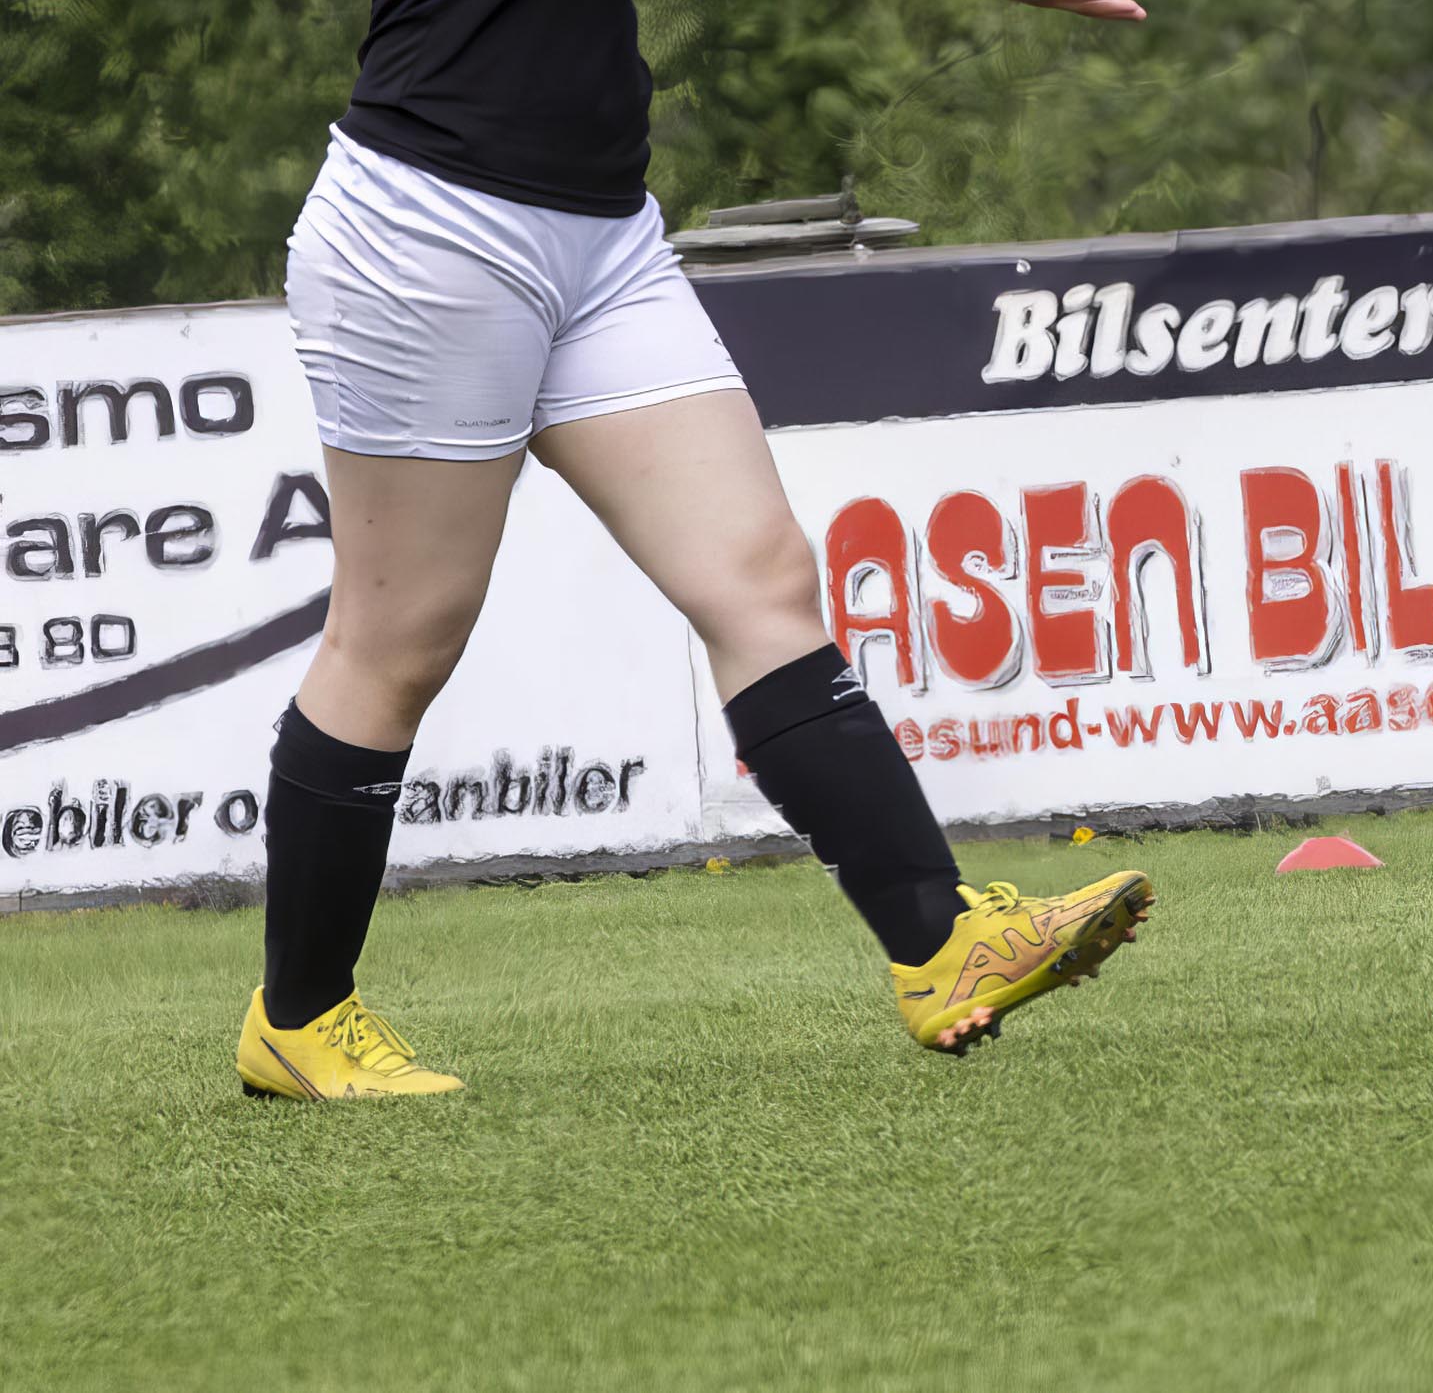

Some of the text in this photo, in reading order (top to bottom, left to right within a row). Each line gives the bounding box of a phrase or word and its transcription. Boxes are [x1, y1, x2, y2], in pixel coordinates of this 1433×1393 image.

[0, 503, 220, 582] are
[40, 613, 138, 670] 80
[0, 745, 646, 859] ebiler o anbiler
